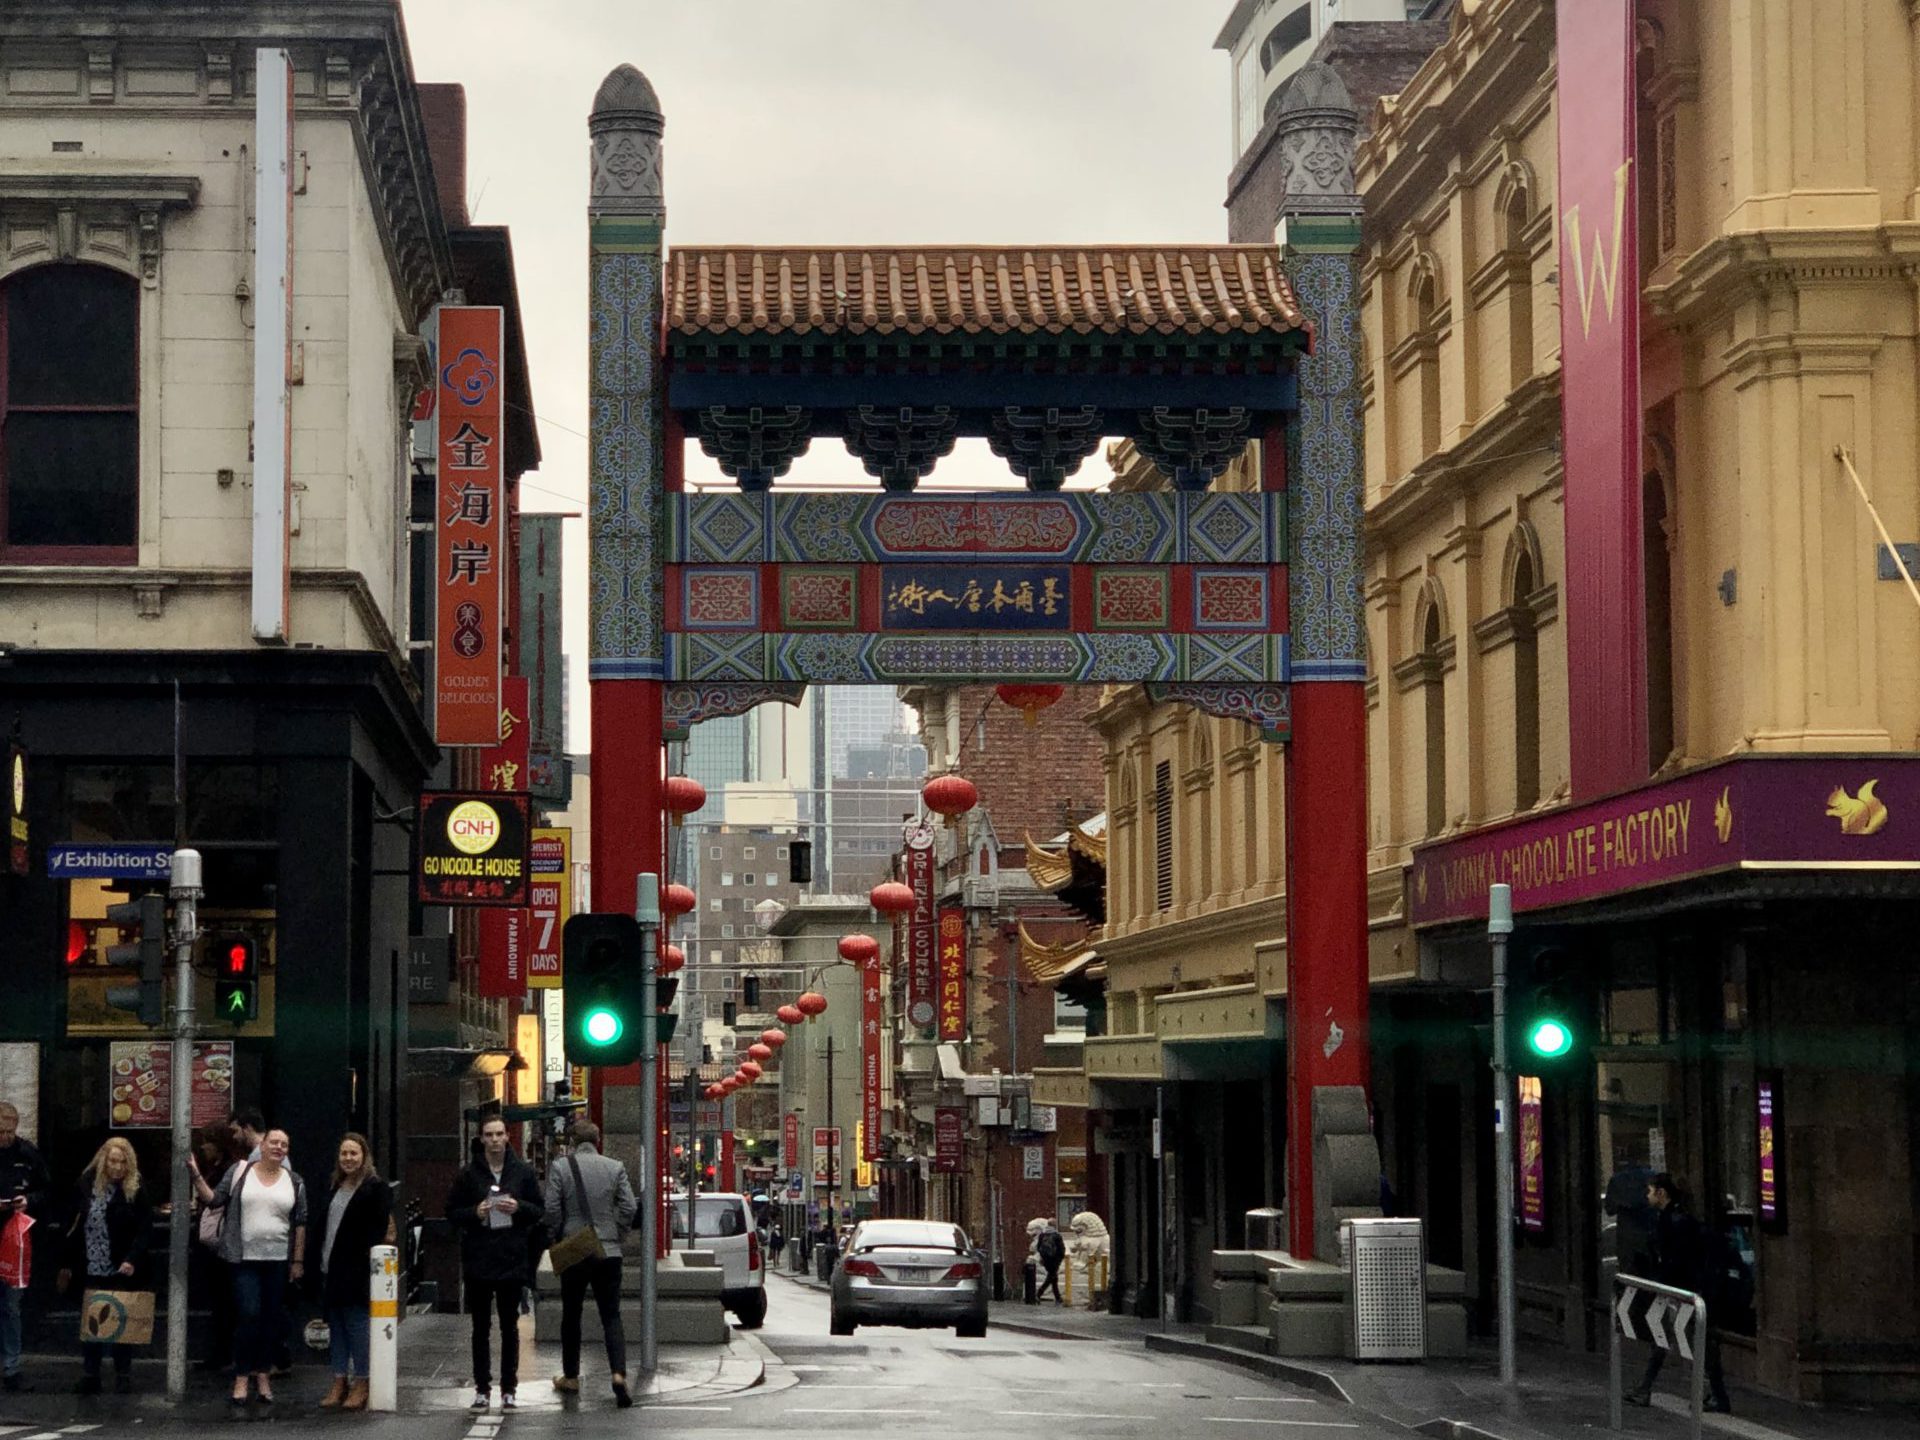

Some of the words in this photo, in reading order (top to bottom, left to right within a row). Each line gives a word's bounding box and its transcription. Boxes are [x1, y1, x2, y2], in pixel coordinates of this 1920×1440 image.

[1562, 157, 1633, 341] W
[444, 420, 492, 586] 金海岸
[460, 605, 479, 656] 美食
[440, 692, 496, 704] DELICIOUS
[444, 676, 489, 687] GOLDEN
[453, 820, 494, 835] GNH
[1501, 825, 1597, 890] CHOCOLATE
[1603, 800, 1692, 872] FACTORY
[65, 852, 152, 867] Exhibition
[531, 843, 562, 852] HEMIST
[424, 856, 439, 875] GO
[441, 857, 483, 876] NOODLE
[485, 858, 521, 877] HOUSE
[532, 888, 558, 905] OPEN
[913, 852, 929, 923] ORIENTAL
[534, 910, 556, 950] 7
[508, 917, 519, 980] PARAMOUNT
[532, 953, 558, 971] DAYS
[914, 930, 930, 996] GOURMET
[942, 943, 961, 1032] 北京同仁堂
[868, 1054, 876, 1087] CHINA
[868, 1090, 876, 1102] OF
[868, 1112, 877, 1155] EMPRESS
